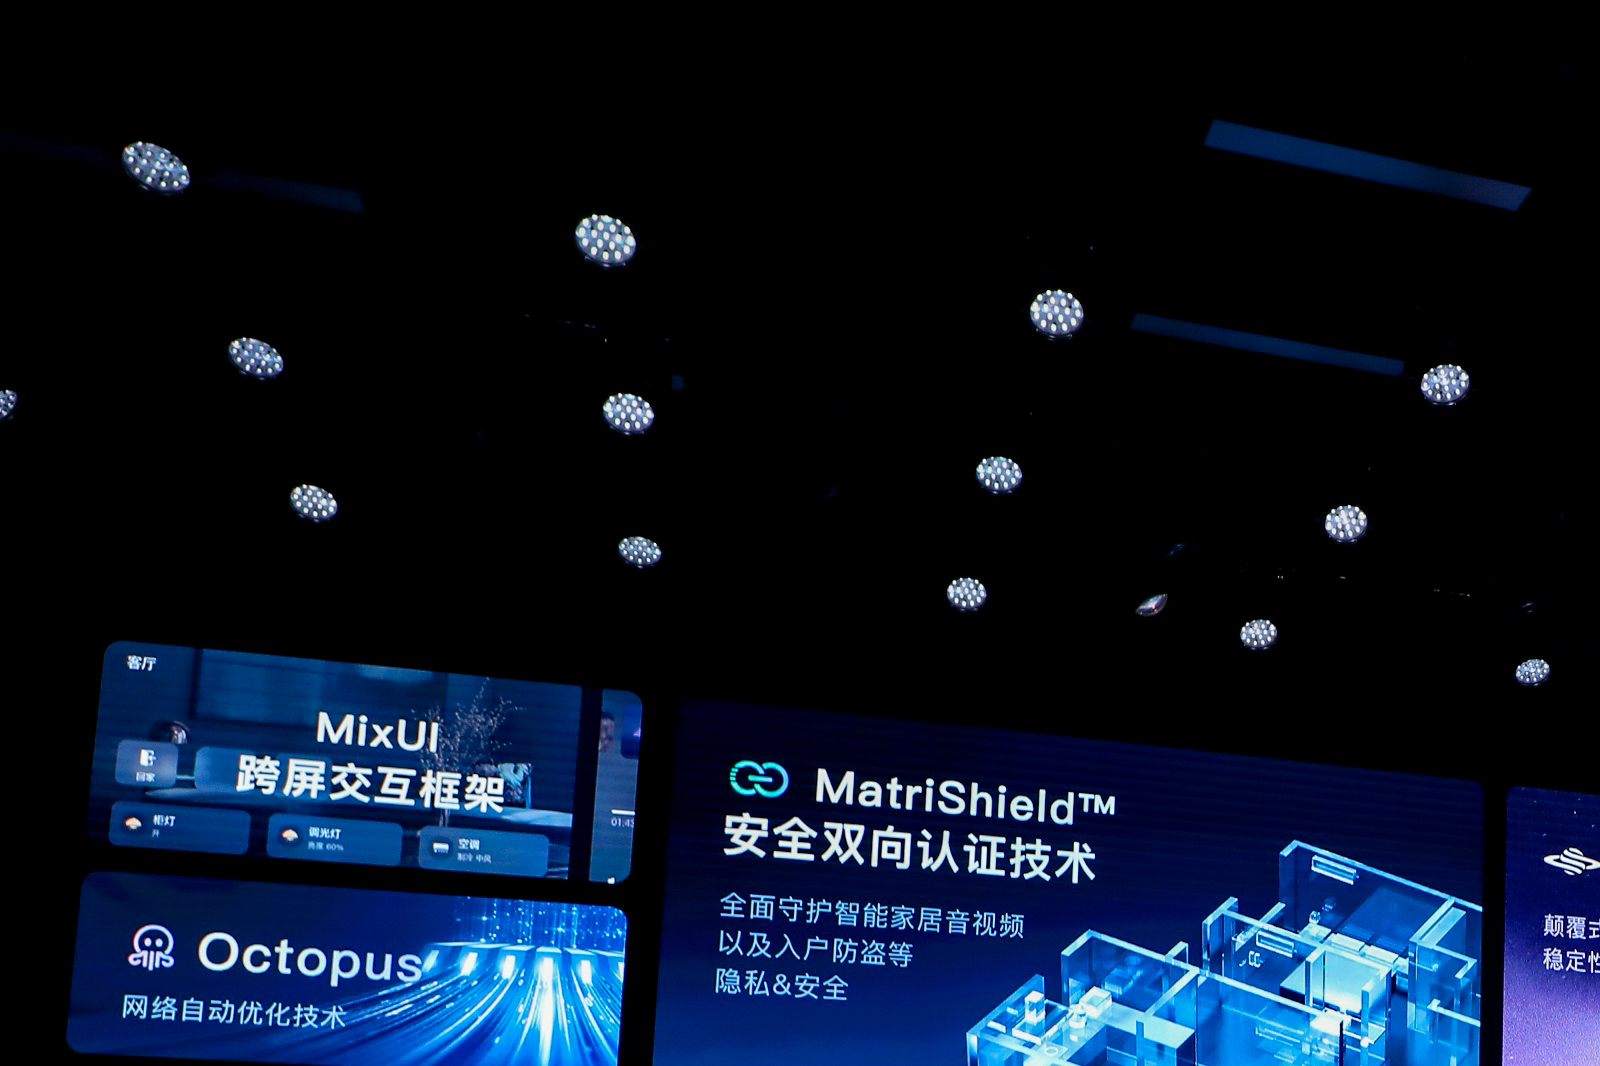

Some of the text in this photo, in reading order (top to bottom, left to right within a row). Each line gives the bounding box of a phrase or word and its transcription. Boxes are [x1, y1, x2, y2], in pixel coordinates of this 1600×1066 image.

[128, 656, 156, 671] 客厅
[315, 710, 441, 754] MixUI
[235, 753, 506, 815] 跨屏交互框架
[723, 812, 1097, 884] 安全双向认证技术
[718, 890, 1027, 941] 全面守护智能家居音视频
[197, 929, 425, 988] Octopus
[717, 929, 915, 969] 以及入户防盗等
[714, 966, 850, 1003] 隐私&安全
[121, 992, 348, 1031] 网络自动优化技术
